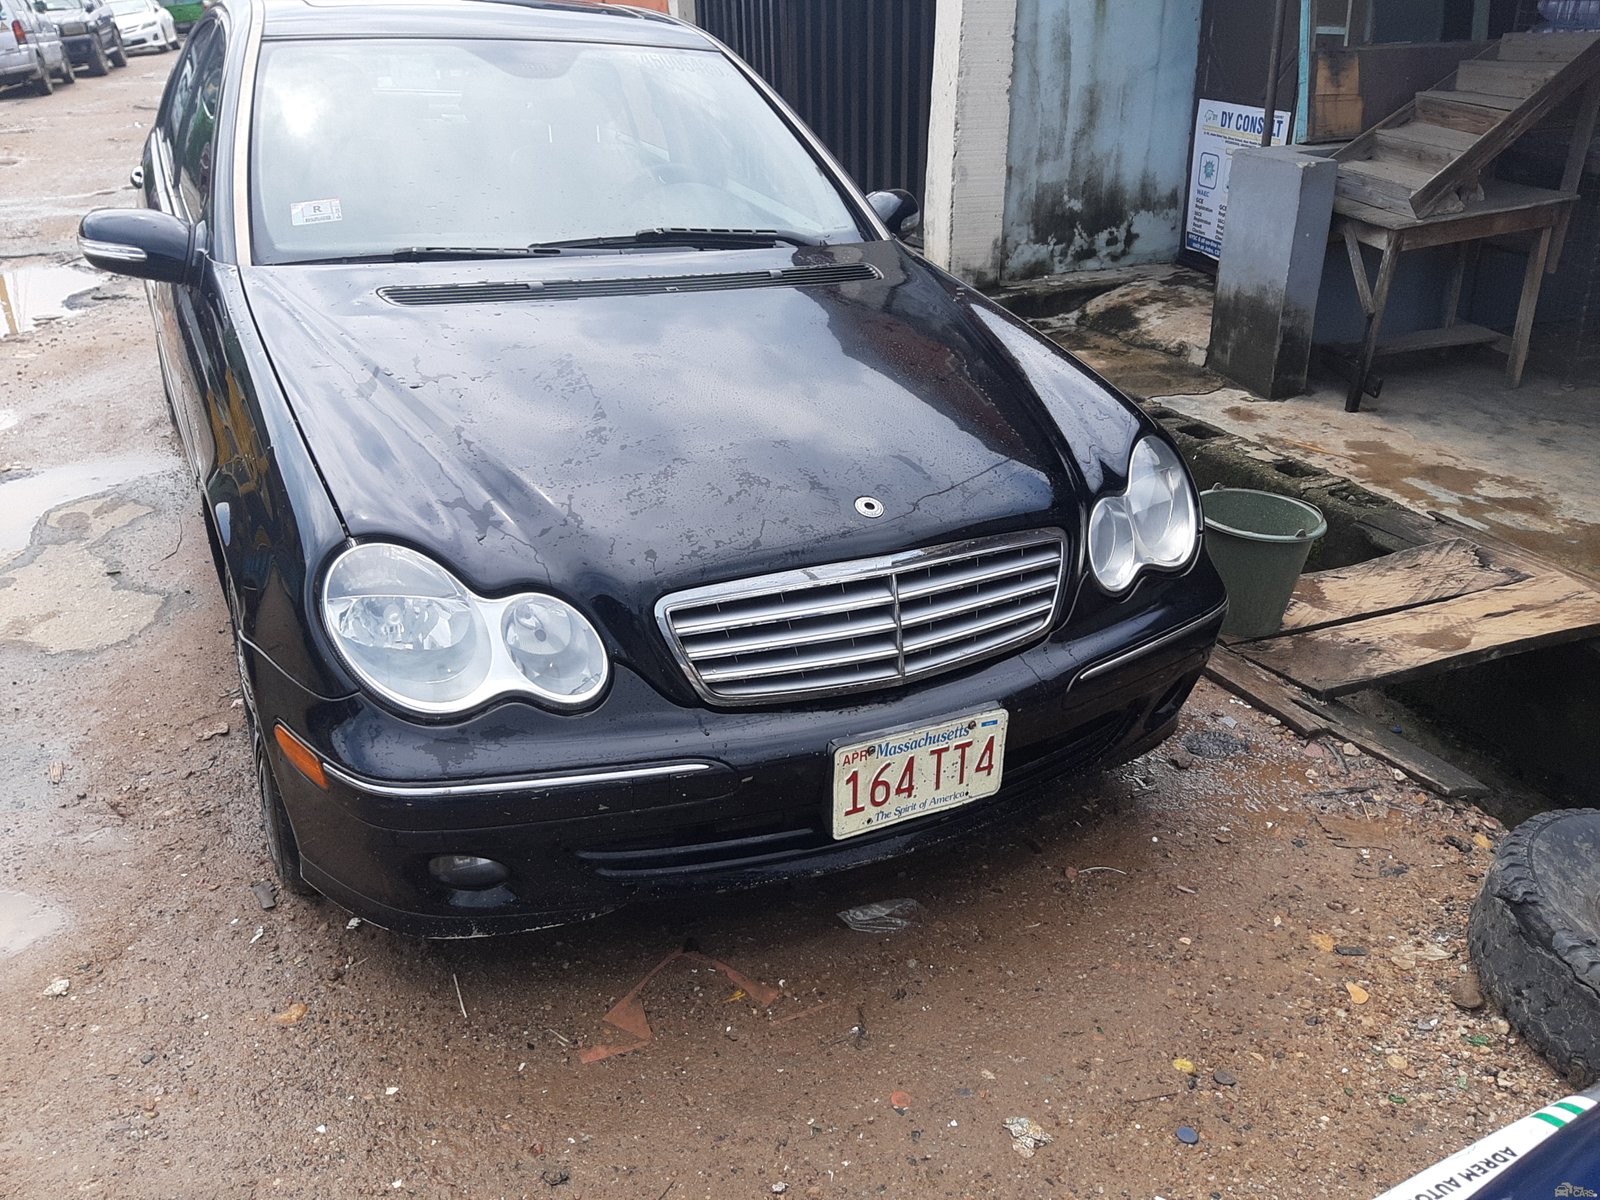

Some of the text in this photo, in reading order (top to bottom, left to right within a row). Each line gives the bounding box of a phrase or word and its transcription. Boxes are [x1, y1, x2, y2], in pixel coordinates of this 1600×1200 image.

[1221, 111, 1234, 129] DY
[1197, 189, 1210, 197] WAEC
[313, 205, 322, 213] R
[876, 726, 970, 759] Massachusetts
[843, 750, 868, 766] APR
[844, 735, 995, 817] 164 TT4
[875, 791, 965, 822] The Spirit of America
[1458, 1146, 1518, 1182] ADREM
